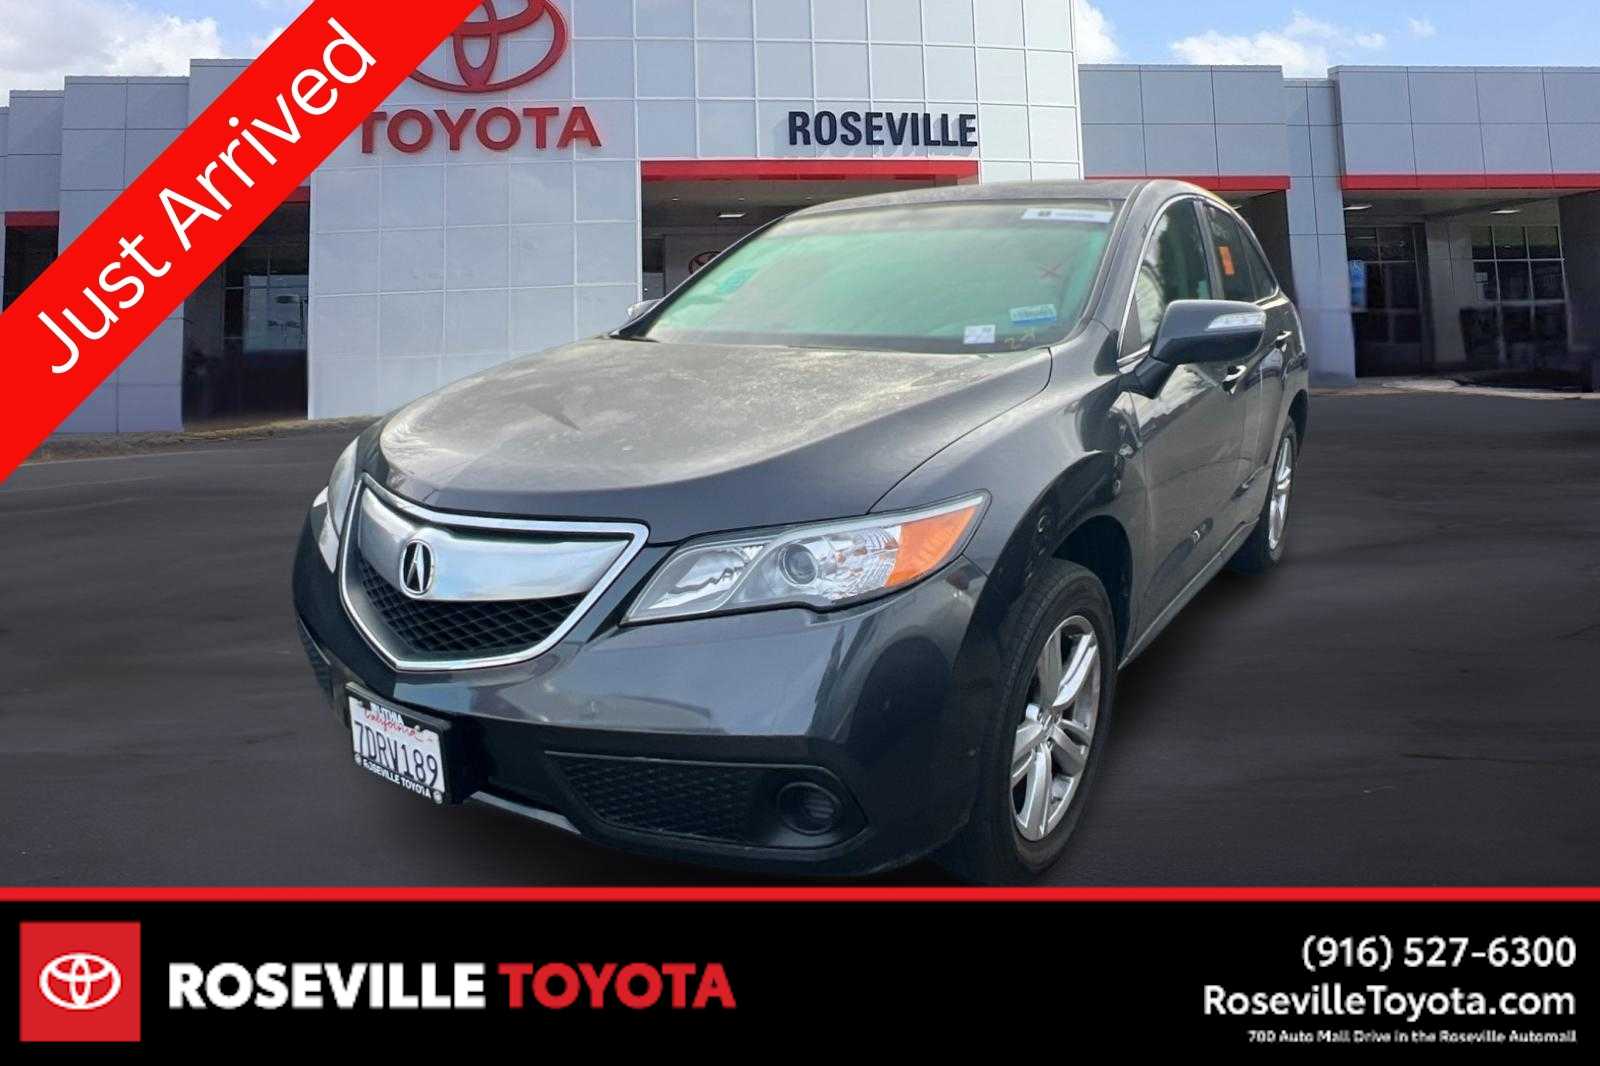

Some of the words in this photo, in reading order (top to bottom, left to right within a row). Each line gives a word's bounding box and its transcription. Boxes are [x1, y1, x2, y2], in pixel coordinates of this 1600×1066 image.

[361, 106, 602, 154] TOYOTA
[787, 110, 978, 148] ROSEVILLE
[354, 720, 439, 788] 7DRV189
[362, 759, 401, 785] ROSEVILLE
[401, 778, 432, 799] TOYOTA
